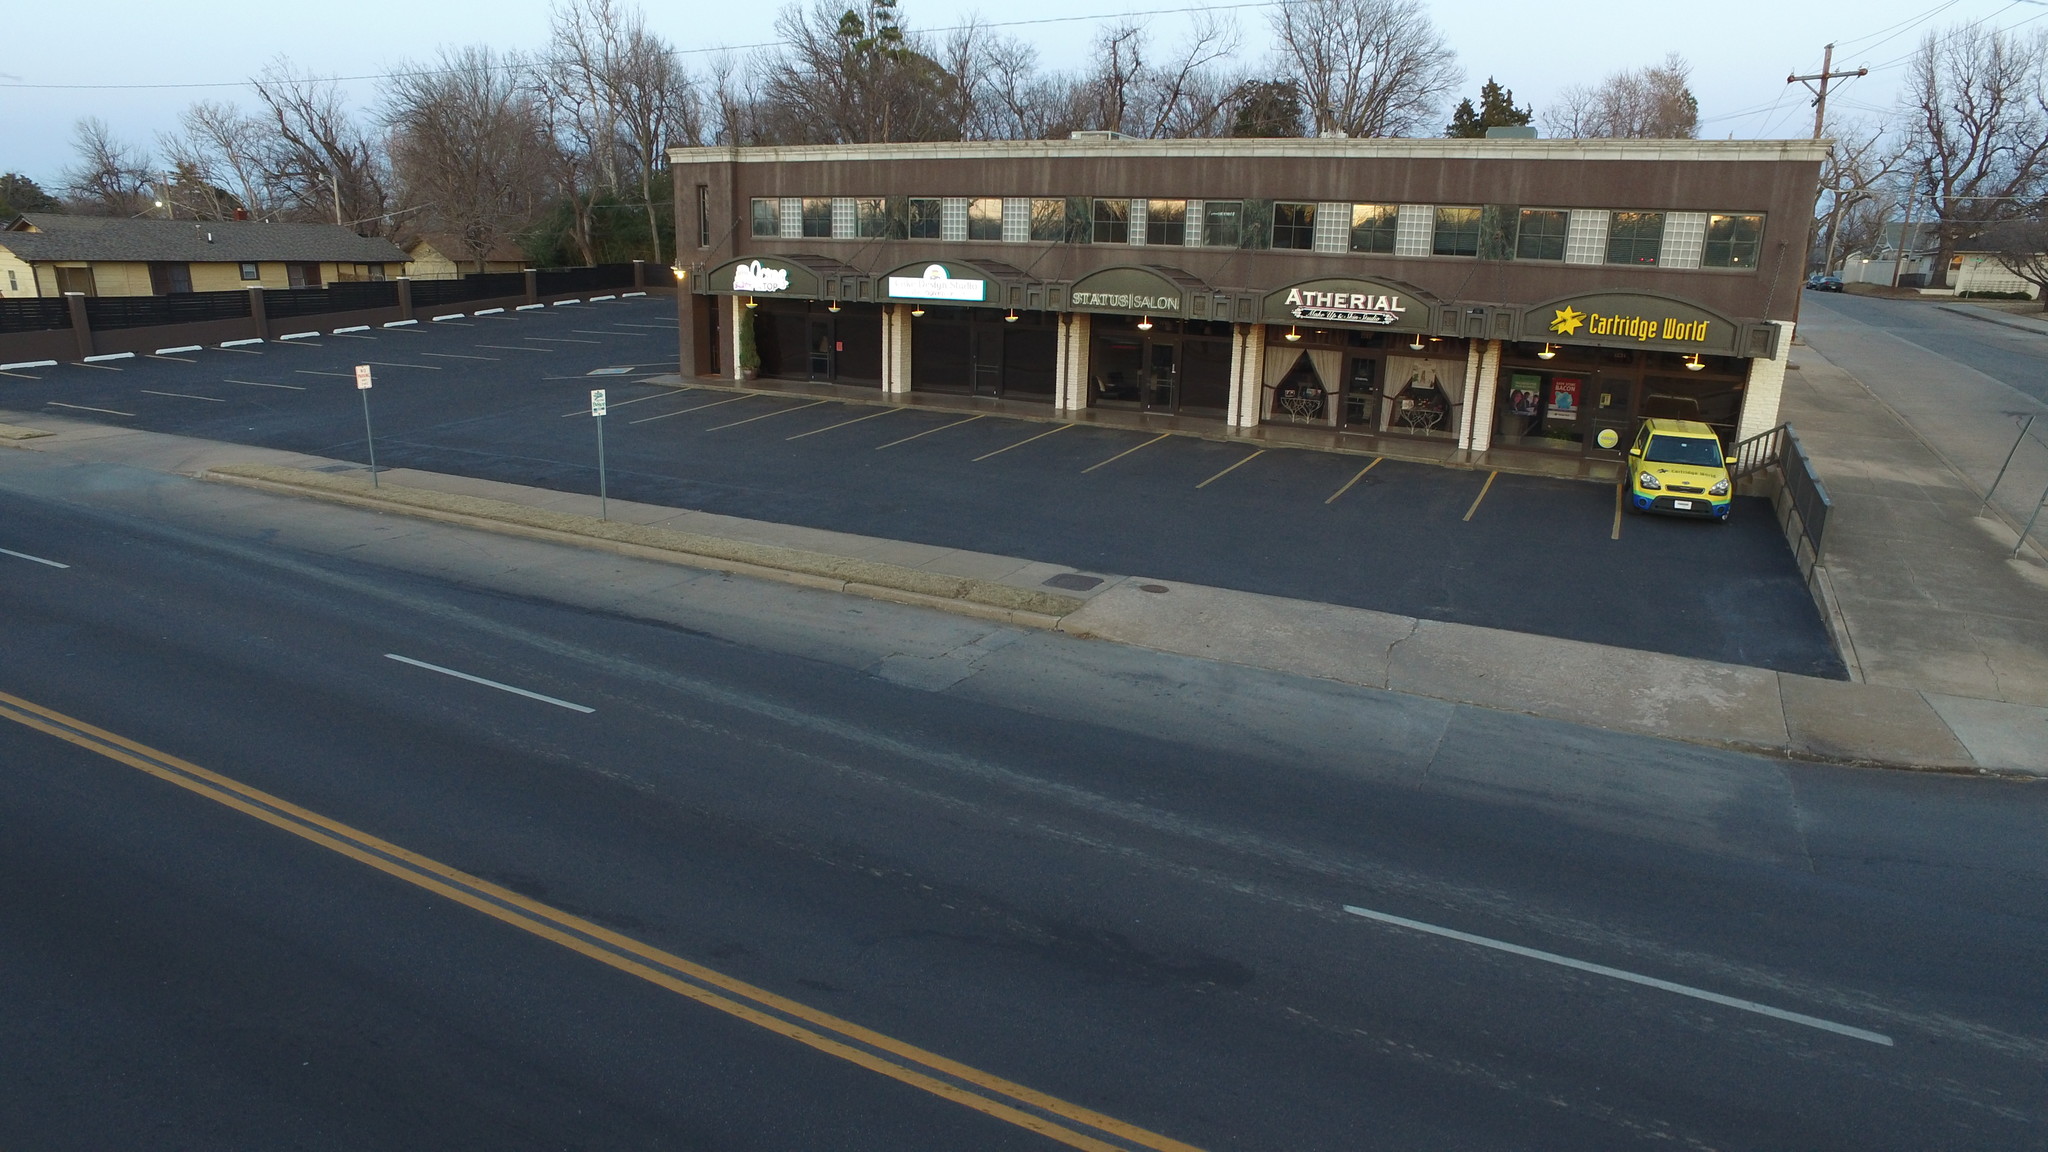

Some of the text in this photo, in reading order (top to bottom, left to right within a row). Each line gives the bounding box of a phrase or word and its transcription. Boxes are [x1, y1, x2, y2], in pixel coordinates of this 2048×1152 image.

[763, 283, 778, 291] TOP
[918, 280, 947, 290] Design
[950, 281, 978, 291] Studio
[1072, 292, 1180, 310] STATUS SALON
[1284, 288, 1406, 312] ATHERIAL
[1589, 313, 1708, 342] Cartridge World
